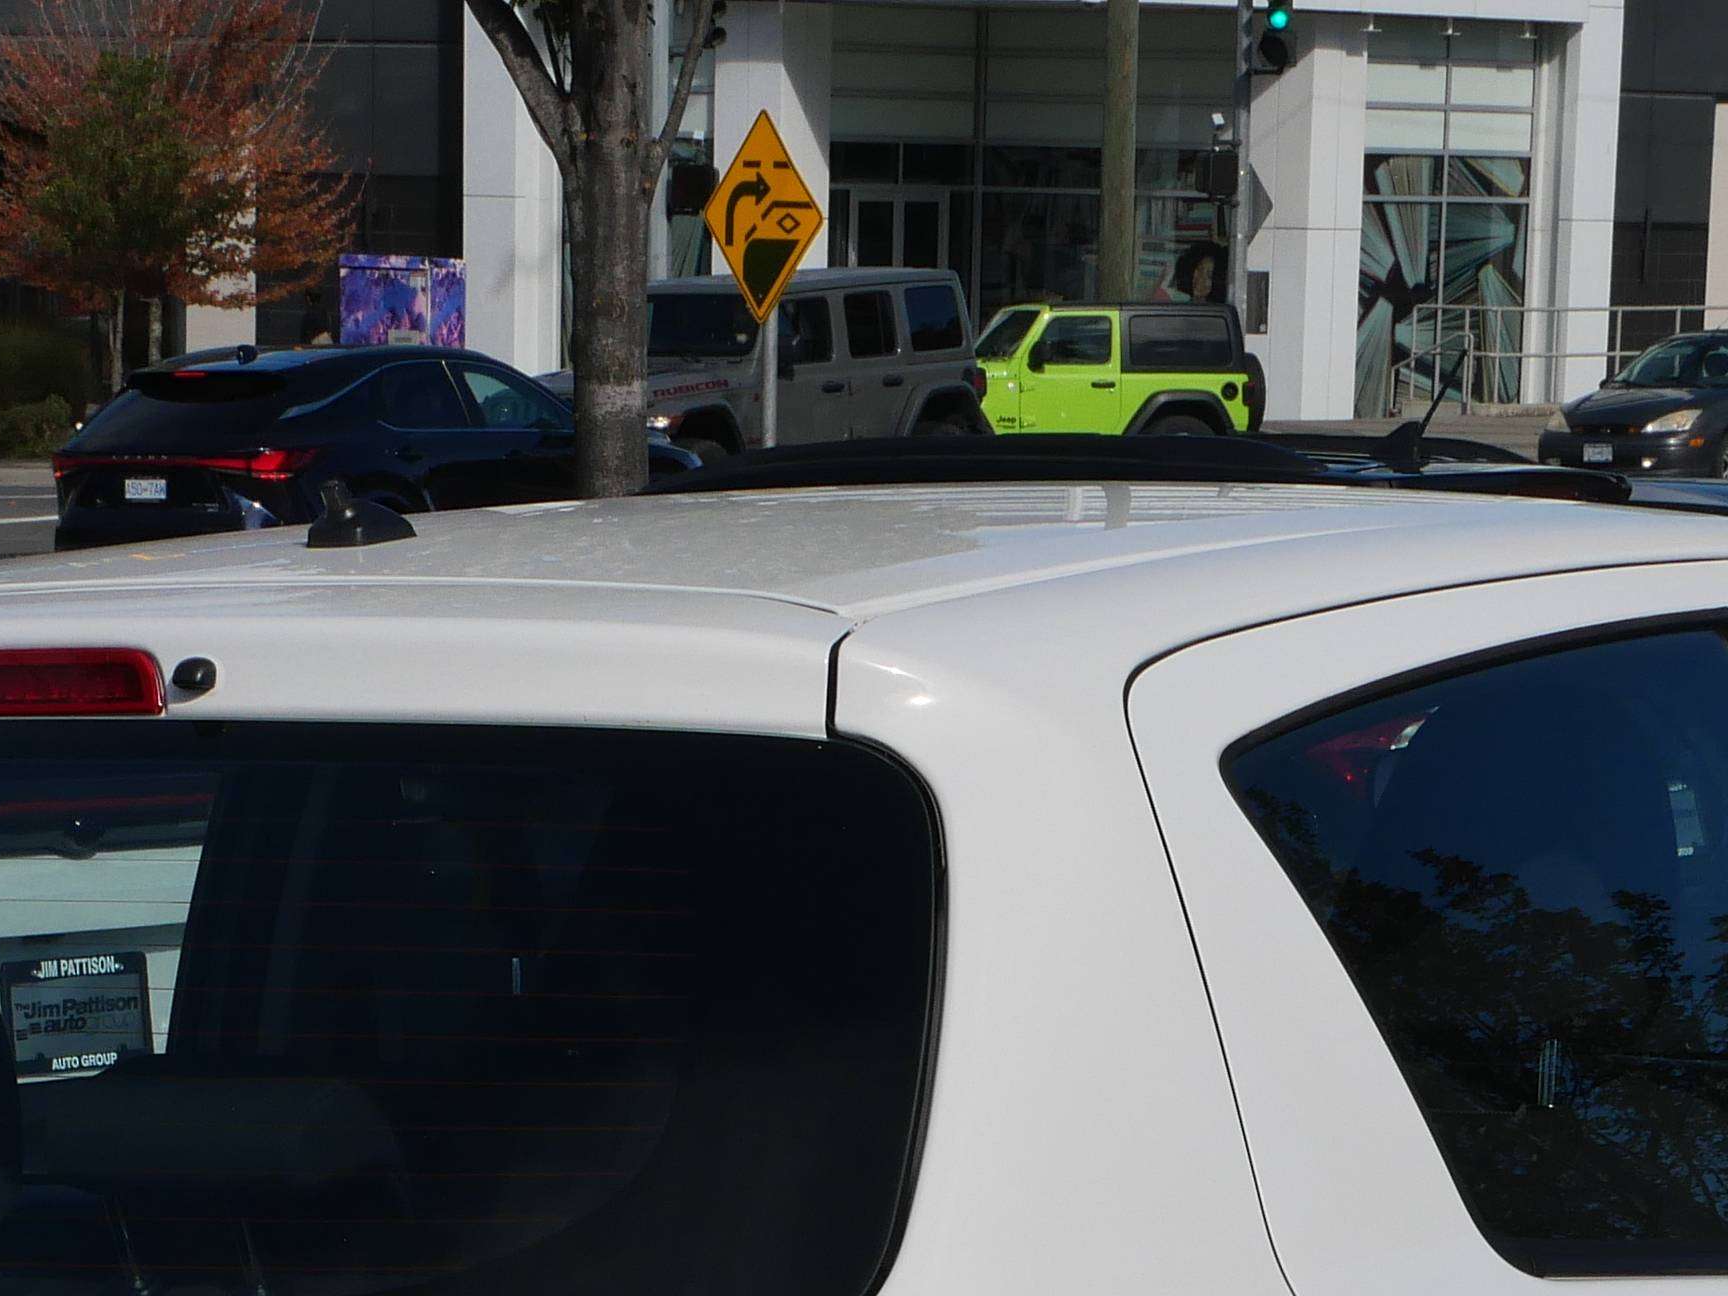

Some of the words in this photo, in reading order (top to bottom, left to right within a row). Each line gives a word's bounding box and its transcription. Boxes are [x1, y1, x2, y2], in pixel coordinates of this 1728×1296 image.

[38, 960, 59, 979] JIM
[60, 956, 115, 976] PATTISON
[52, 1057, 79, 1071] AUTO
[81, 1052, 118, 1067] GROUP
